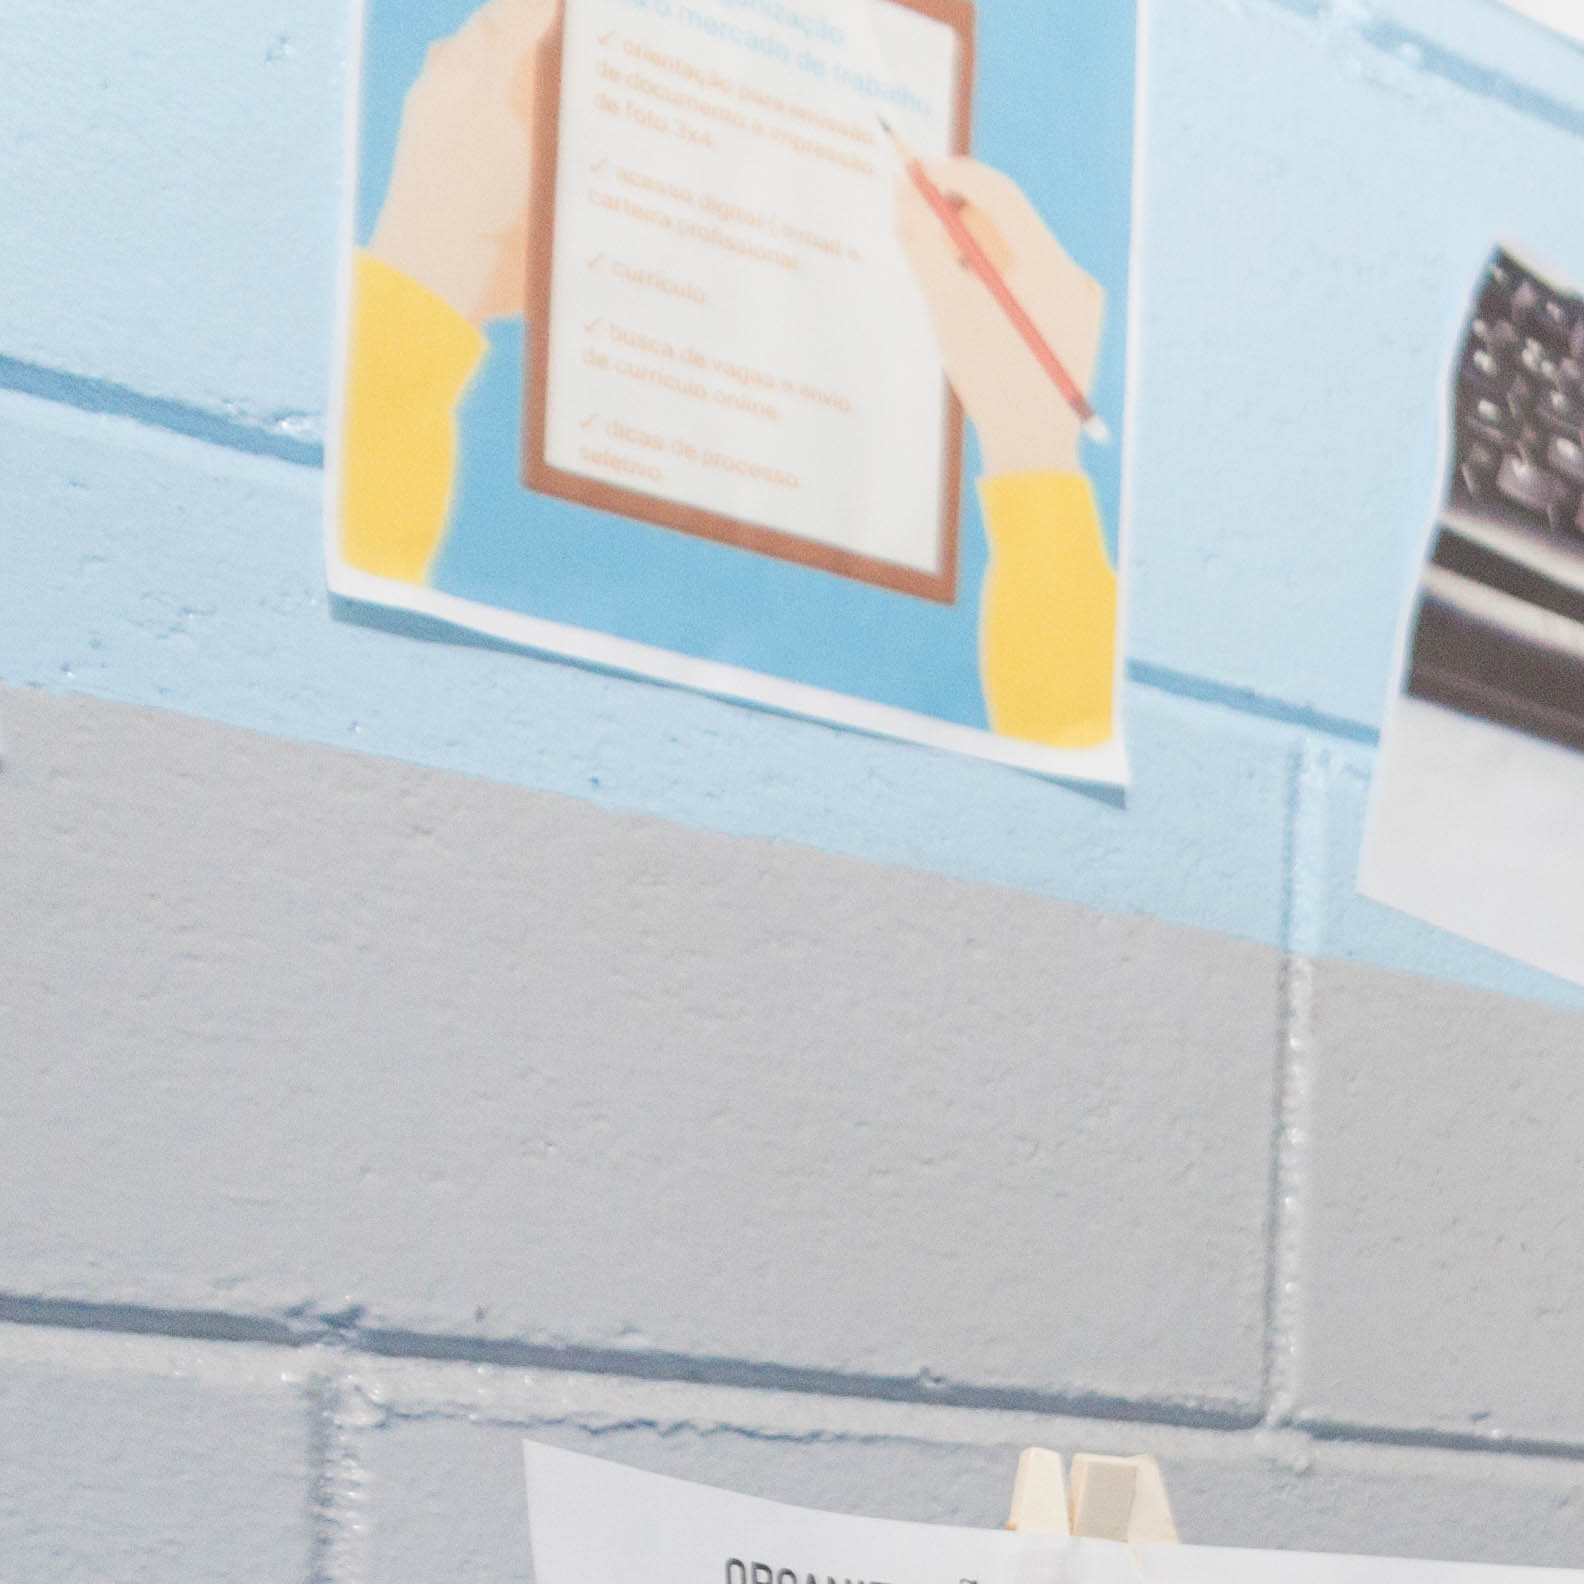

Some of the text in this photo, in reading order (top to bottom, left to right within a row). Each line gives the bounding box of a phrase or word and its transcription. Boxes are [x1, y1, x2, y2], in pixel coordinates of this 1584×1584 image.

[595, 59, 621, 83] de
[678, 6, 790, 63] mercado
[796, 51, 826, 77] de
[834, 62, 932, 116] trabalho
[593, 91, 619, 116] de
[587, 188, 671, 228] carteira
[581, 346, 609, 371] de
[607, 321, 675, 361] busca
[680, 346, 706, 369] de
[712, 359, 776, 390] vagas
[605, 418, 665, 451] dicas
[671, 438, 698, 460] de
